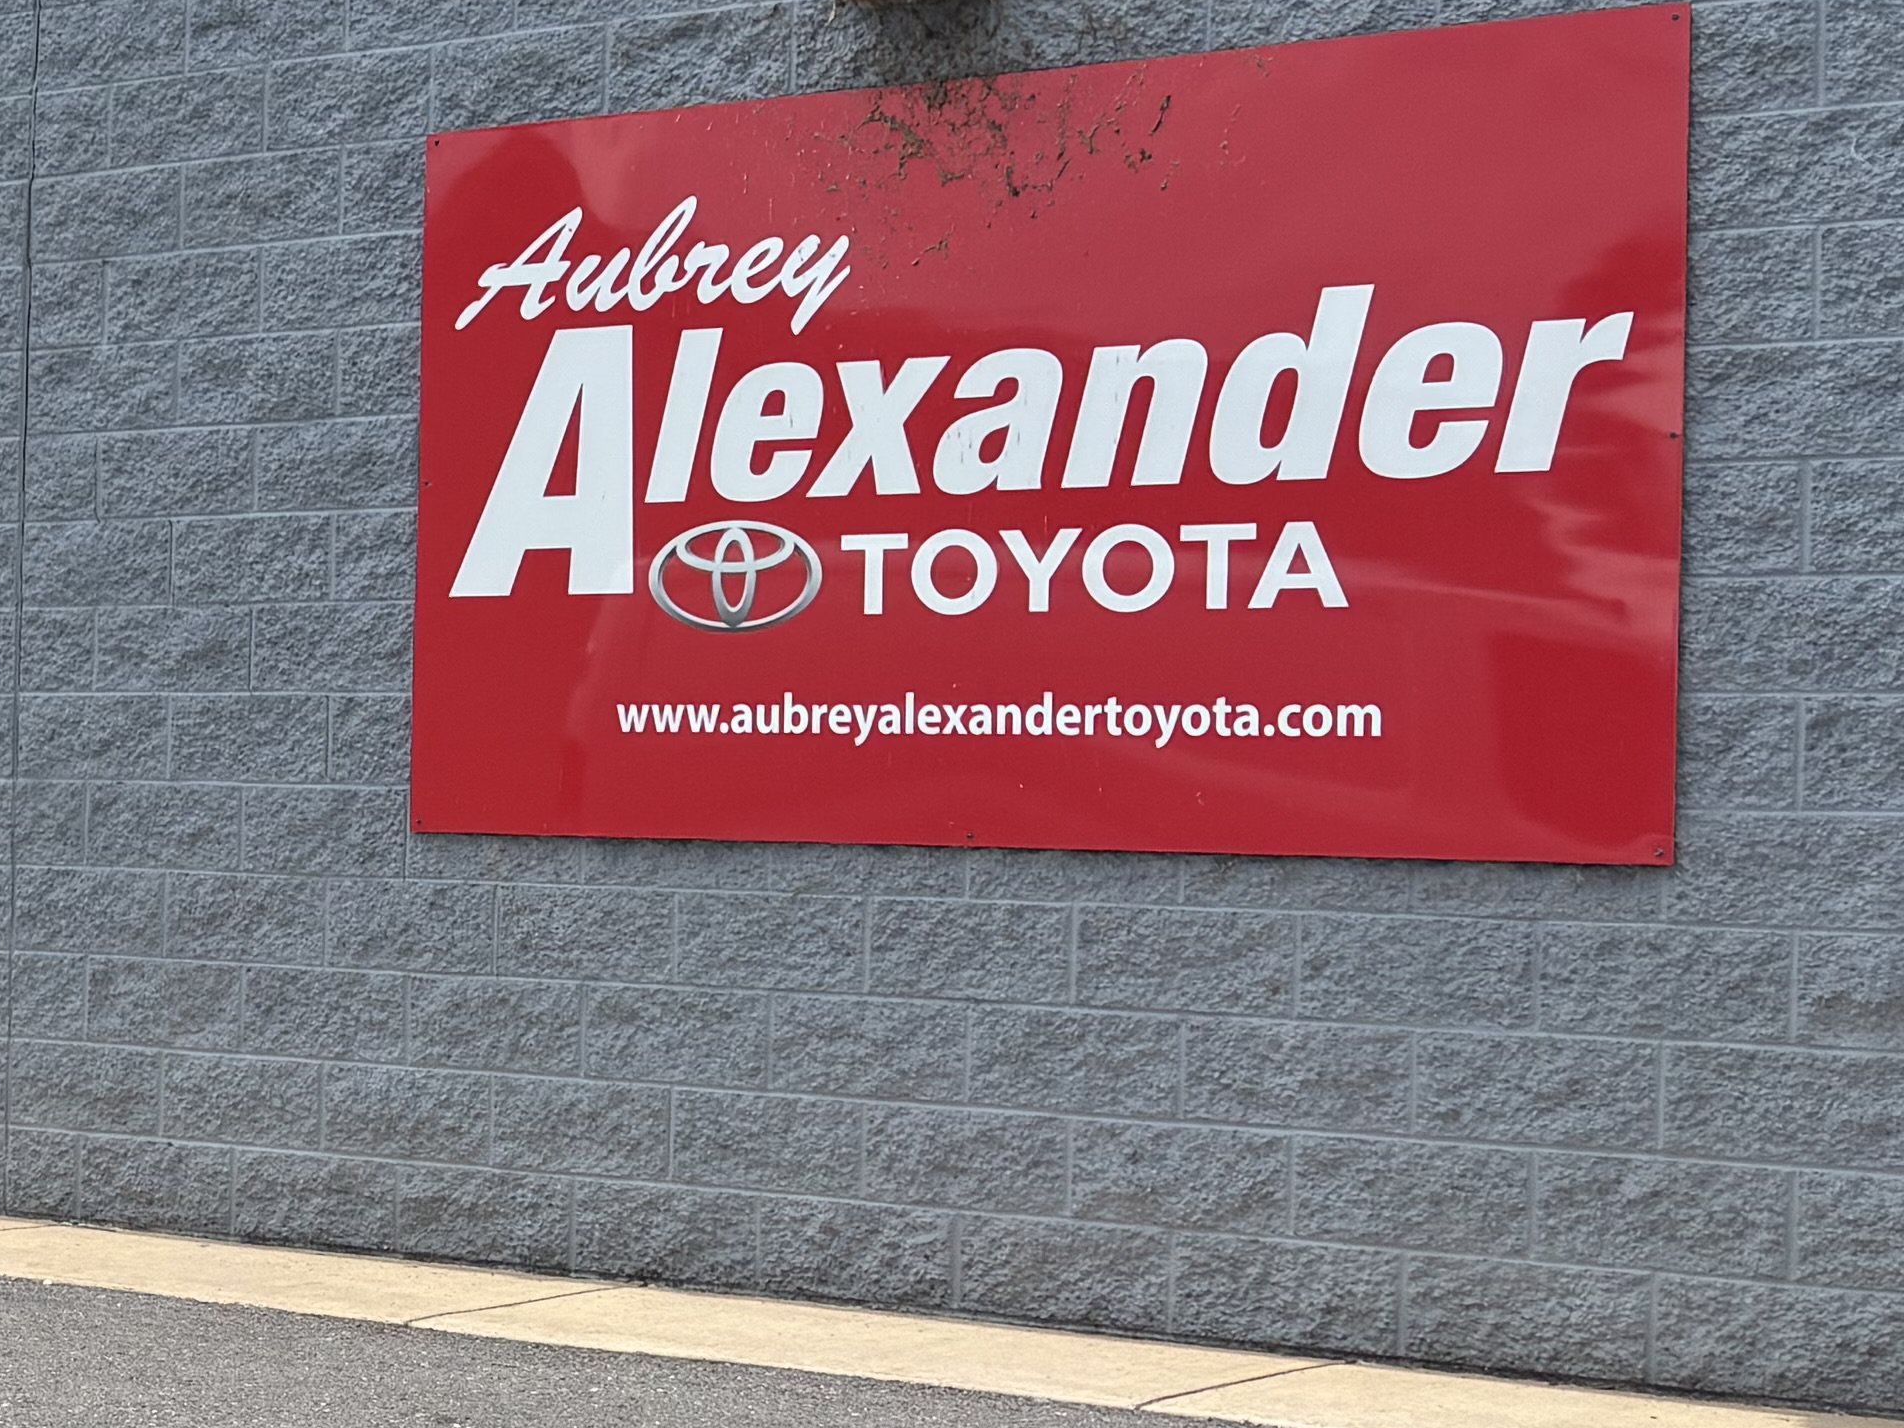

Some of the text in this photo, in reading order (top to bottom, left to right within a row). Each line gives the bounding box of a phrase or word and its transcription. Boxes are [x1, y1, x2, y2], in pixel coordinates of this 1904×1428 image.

[455, 195, 851, 336] Aubrey
[448, 283, 1634, 598] Alexander
[840, 521, 1349, 617] TOYOTA
[616, 691, 1382, 749] www.aubreyalexandertoyota.com
